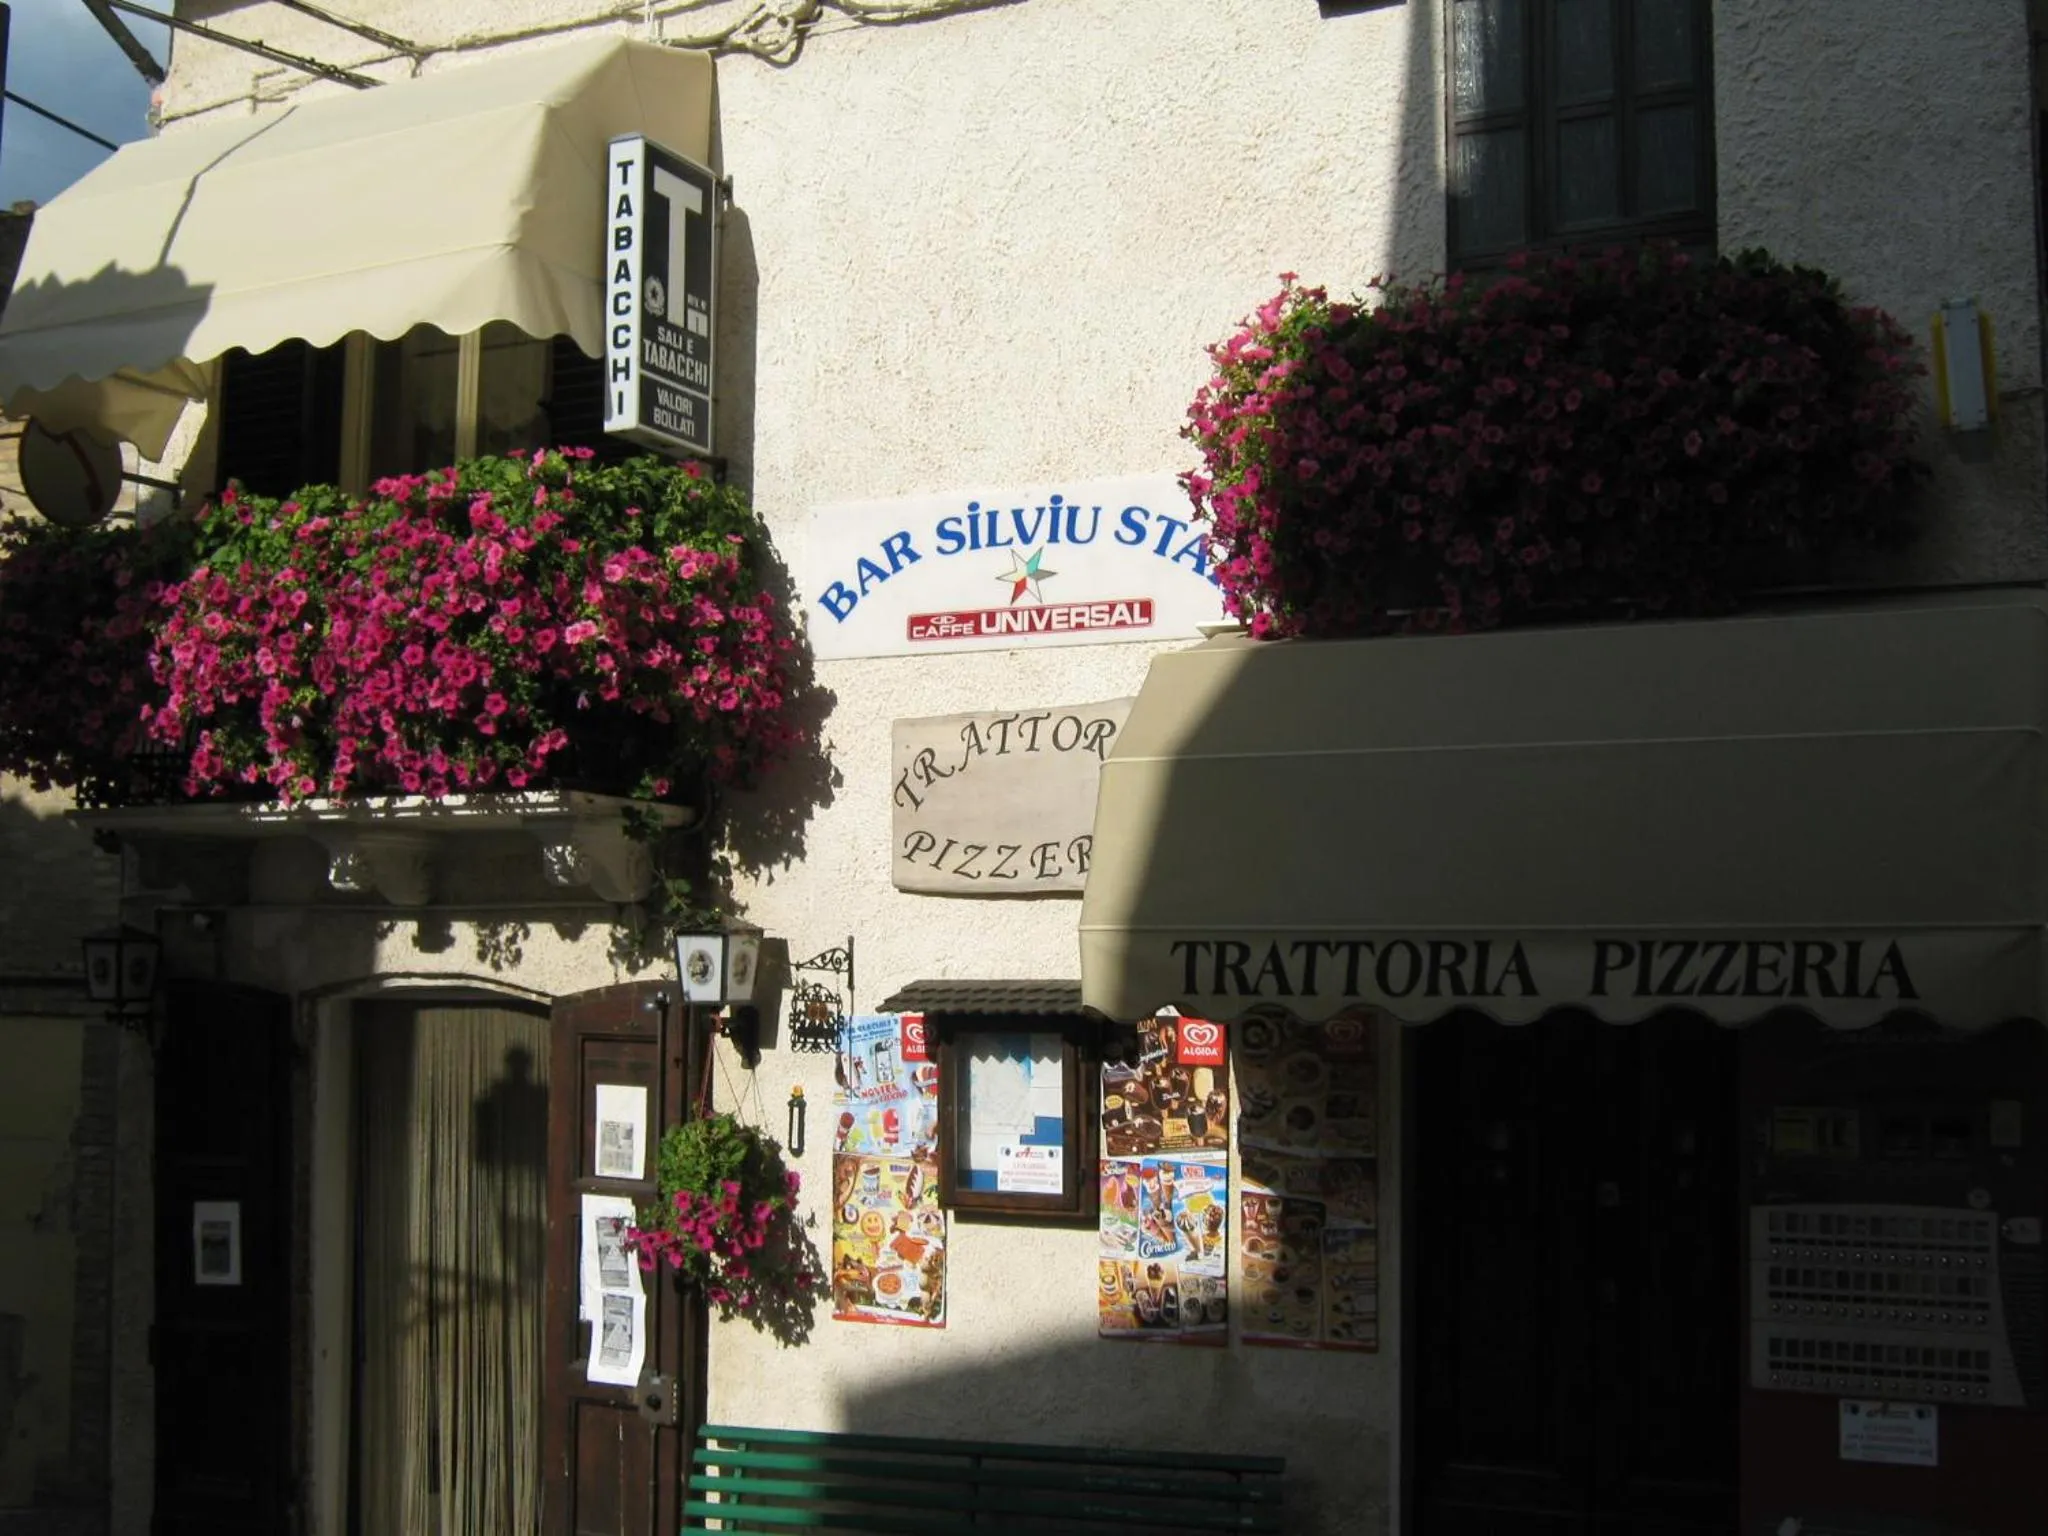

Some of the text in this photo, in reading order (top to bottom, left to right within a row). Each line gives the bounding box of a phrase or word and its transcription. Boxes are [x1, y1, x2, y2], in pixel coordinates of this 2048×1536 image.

[654, 165, 703, 328] T
[612, 160, 634, 415] TABACCHI
[643, 338, 708, 388] TABACCHI
[658, 326, 694, 355] SALI E
[653, 405, 696, 438] BOLLATI
[657, 387, 693, 417] VALORI
[818, 530, 922, 623] BAR
[1114, 506, 1224, 592] STA
[981, 602, 1150, 635] UNIVERSAL
[894, 712, 1116, 812] TRATTOR
[1171, 938, 1920, 1000] TRATTORIA PIZZERIA
